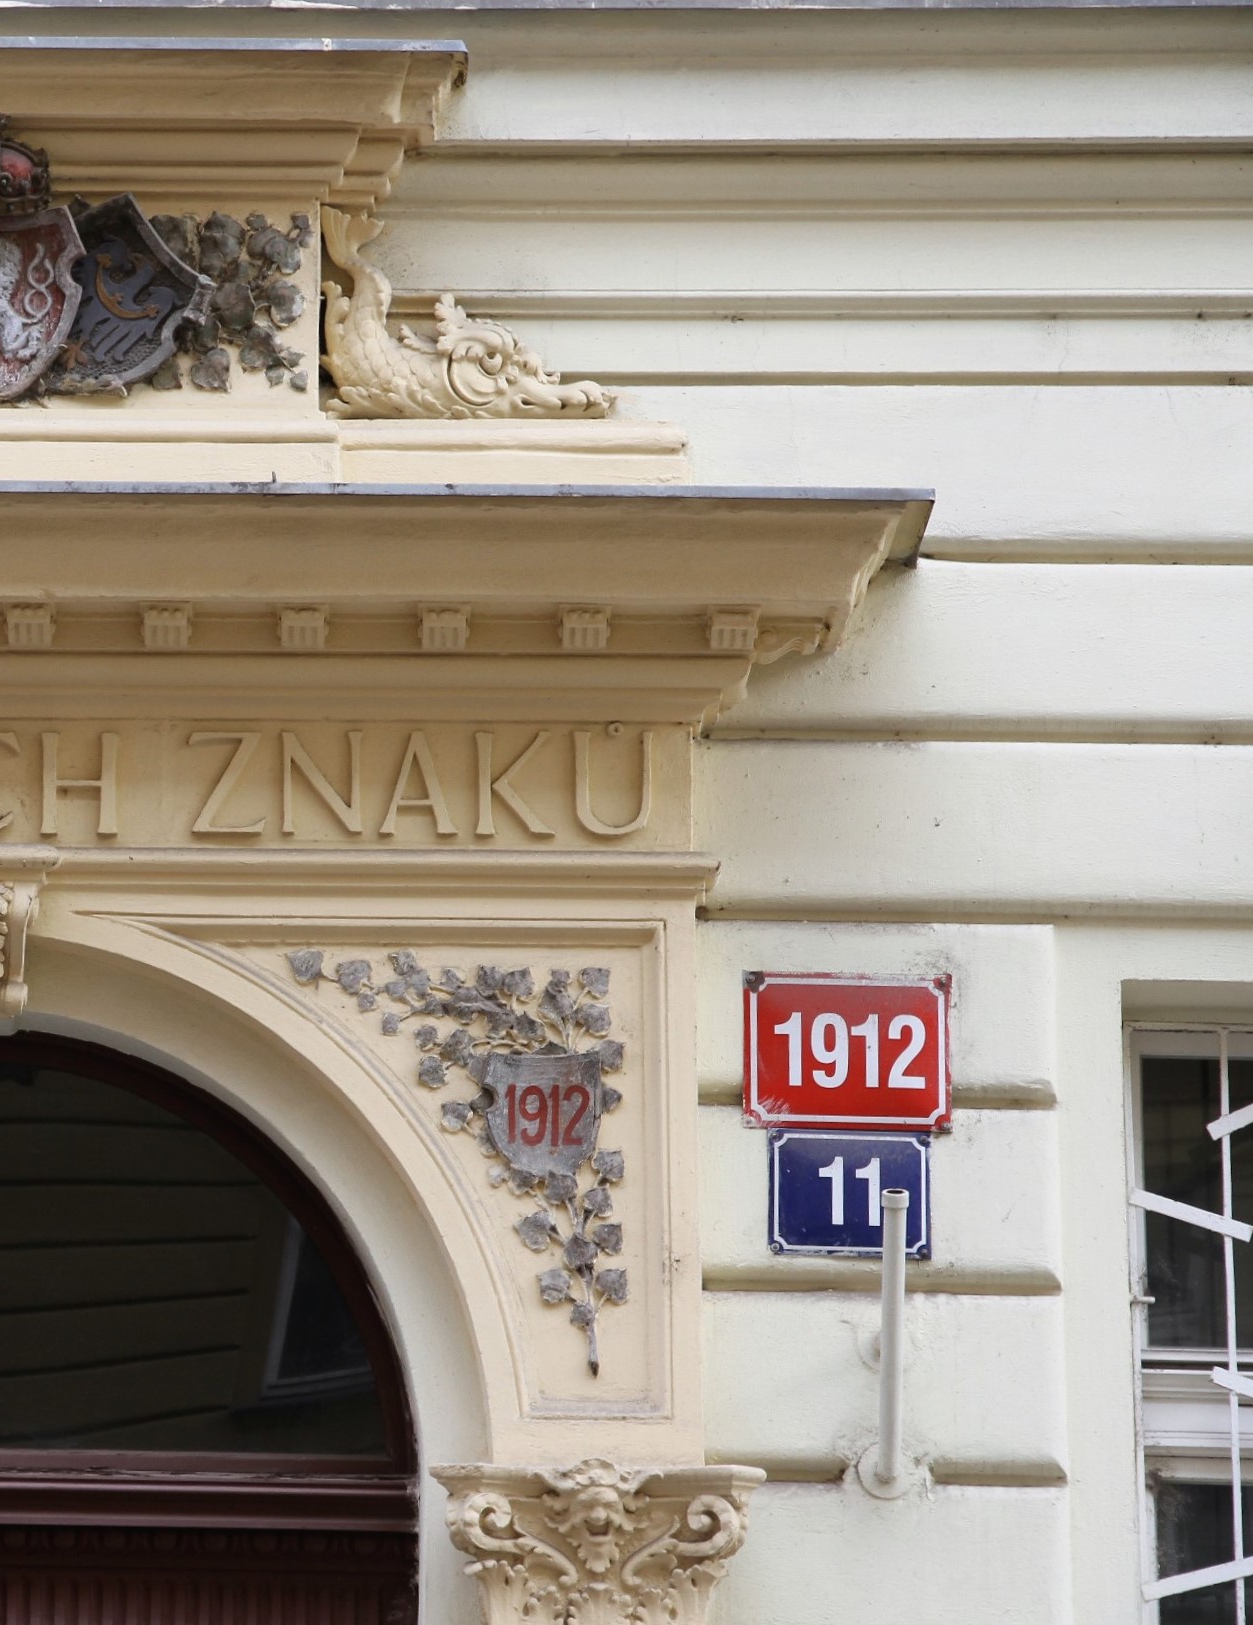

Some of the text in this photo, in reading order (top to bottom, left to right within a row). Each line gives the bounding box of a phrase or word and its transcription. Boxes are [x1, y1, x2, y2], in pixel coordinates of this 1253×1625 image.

[774, 1011, 926, 1090] 1912
[504, 1083, 590, 1147] 1912
[818, 1156, 881, 1227] 11
